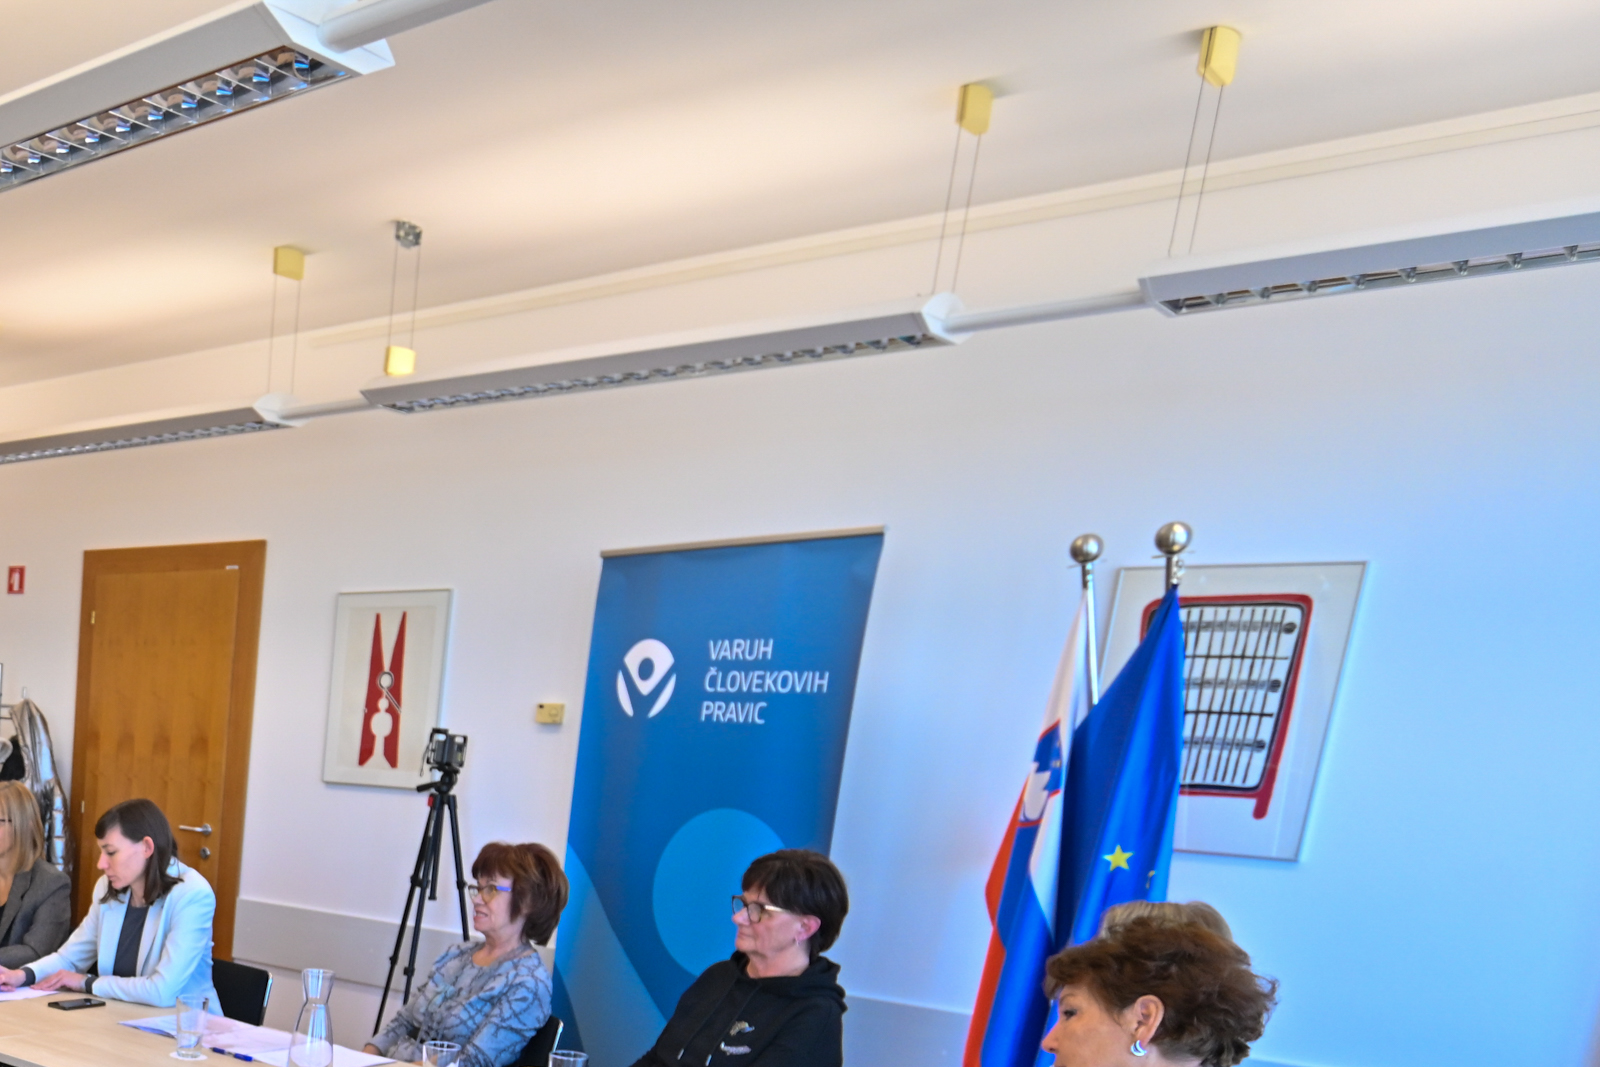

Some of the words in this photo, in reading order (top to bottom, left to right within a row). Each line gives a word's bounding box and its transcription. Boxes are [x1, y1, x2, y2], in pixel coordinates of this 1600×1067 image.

[710, 638, 773, 661] VARUH
[704, 666, 830, 694] ČLOVEKOVIH
[701, 700, 768, 725] PRAVIC
